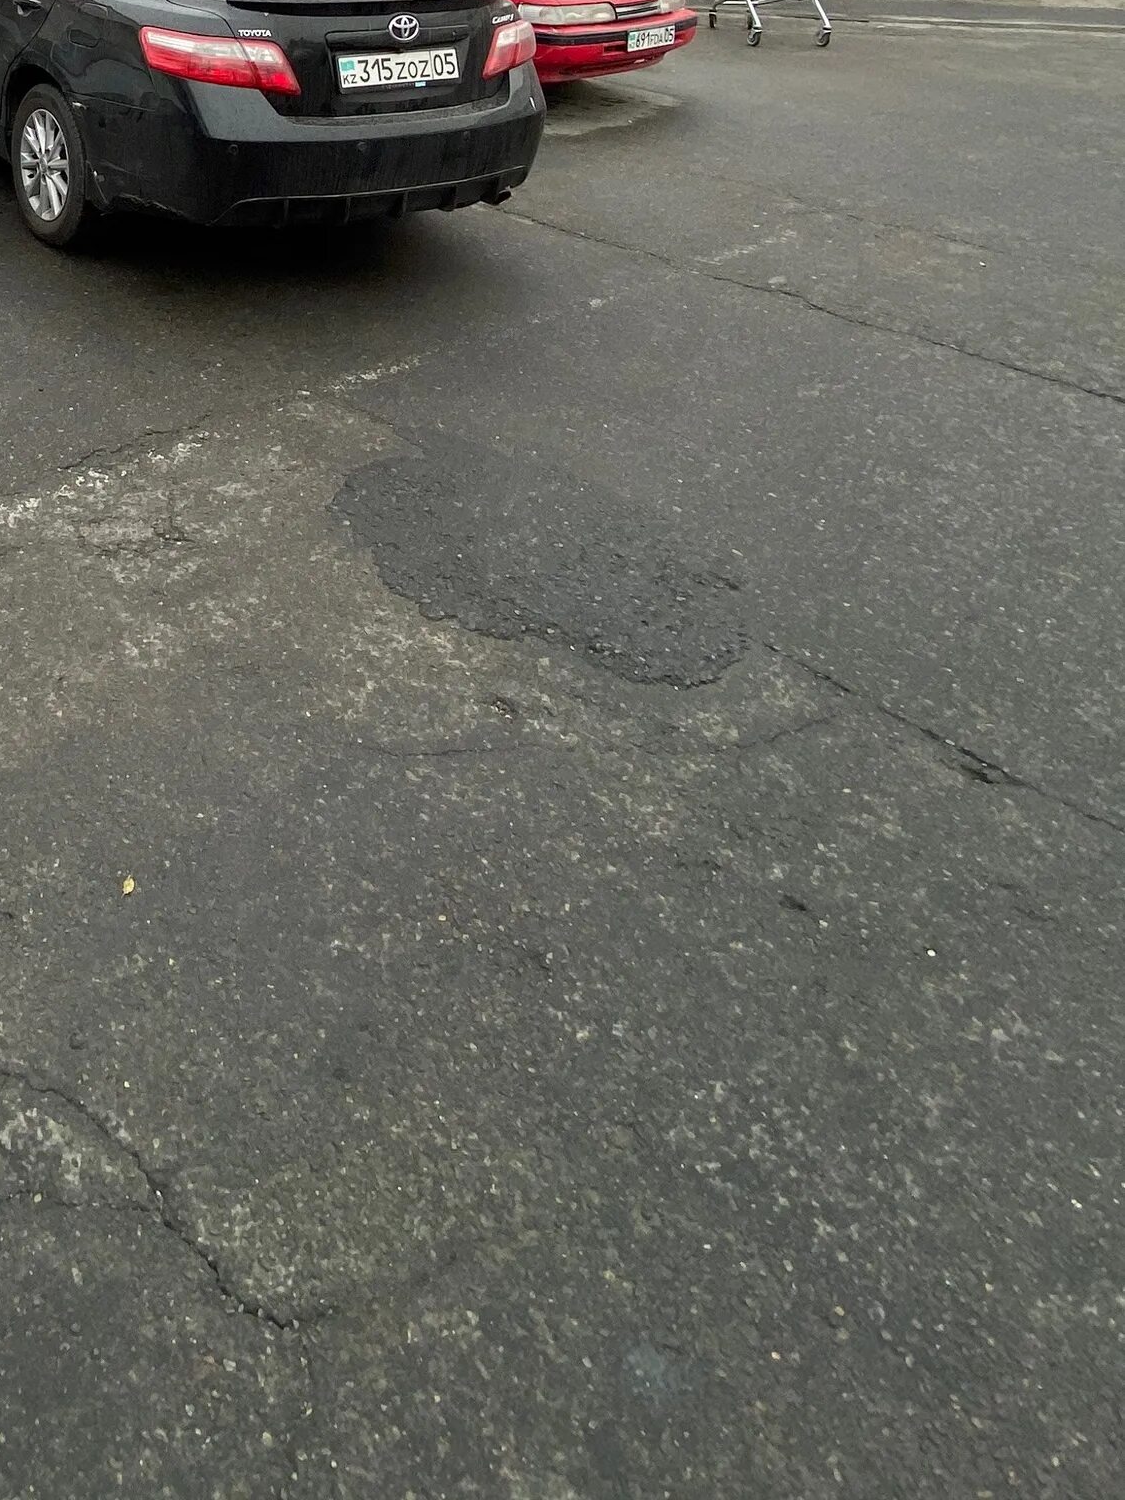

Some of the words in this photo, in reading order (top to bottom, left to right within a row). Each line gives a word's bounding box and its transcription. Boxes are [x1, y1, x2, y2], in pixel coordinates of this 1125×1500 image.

[238, 29, 272, 37] TOYOTA
[357, 58, 393, 82] 315
[433, 53, 455, 76] 05
[343, 74, 357, 84] KZ
